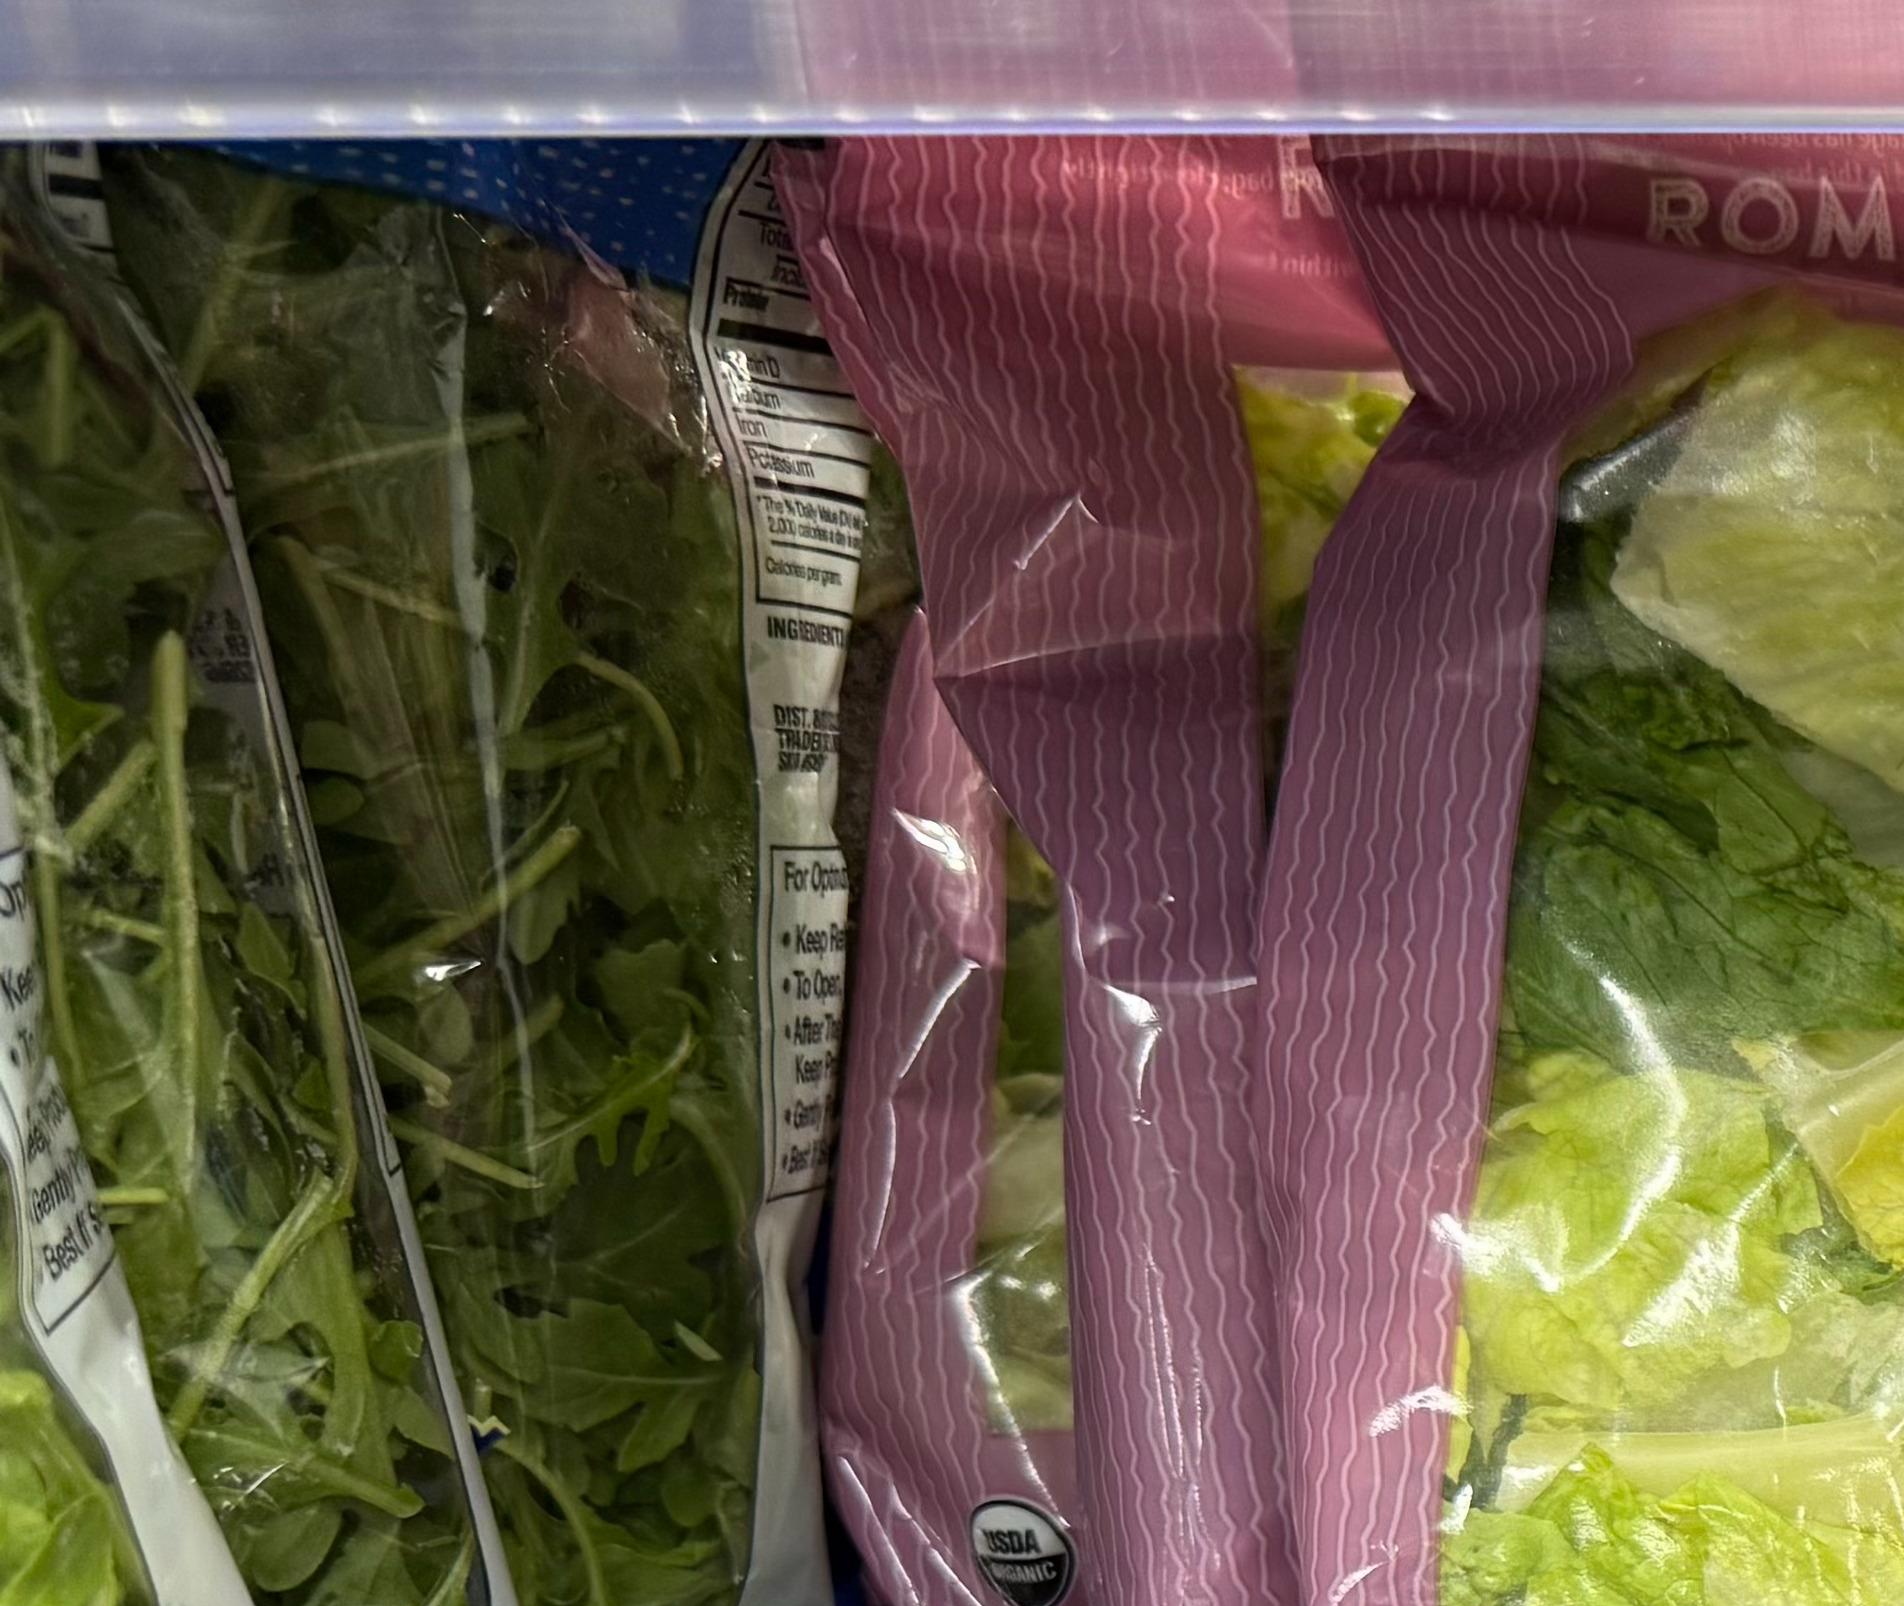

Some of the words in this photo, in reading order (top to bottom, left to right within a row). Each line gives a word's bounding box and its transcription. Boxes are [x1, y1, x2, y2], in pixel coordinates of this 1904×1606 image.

[784, 861, 809, 892] For
[796, 923, 828, 961] Keep
[793, 969, 811, 1001] To
[42, 1224, 84, 1283] Best
[982, 1528, 1042, 1555] USDA
